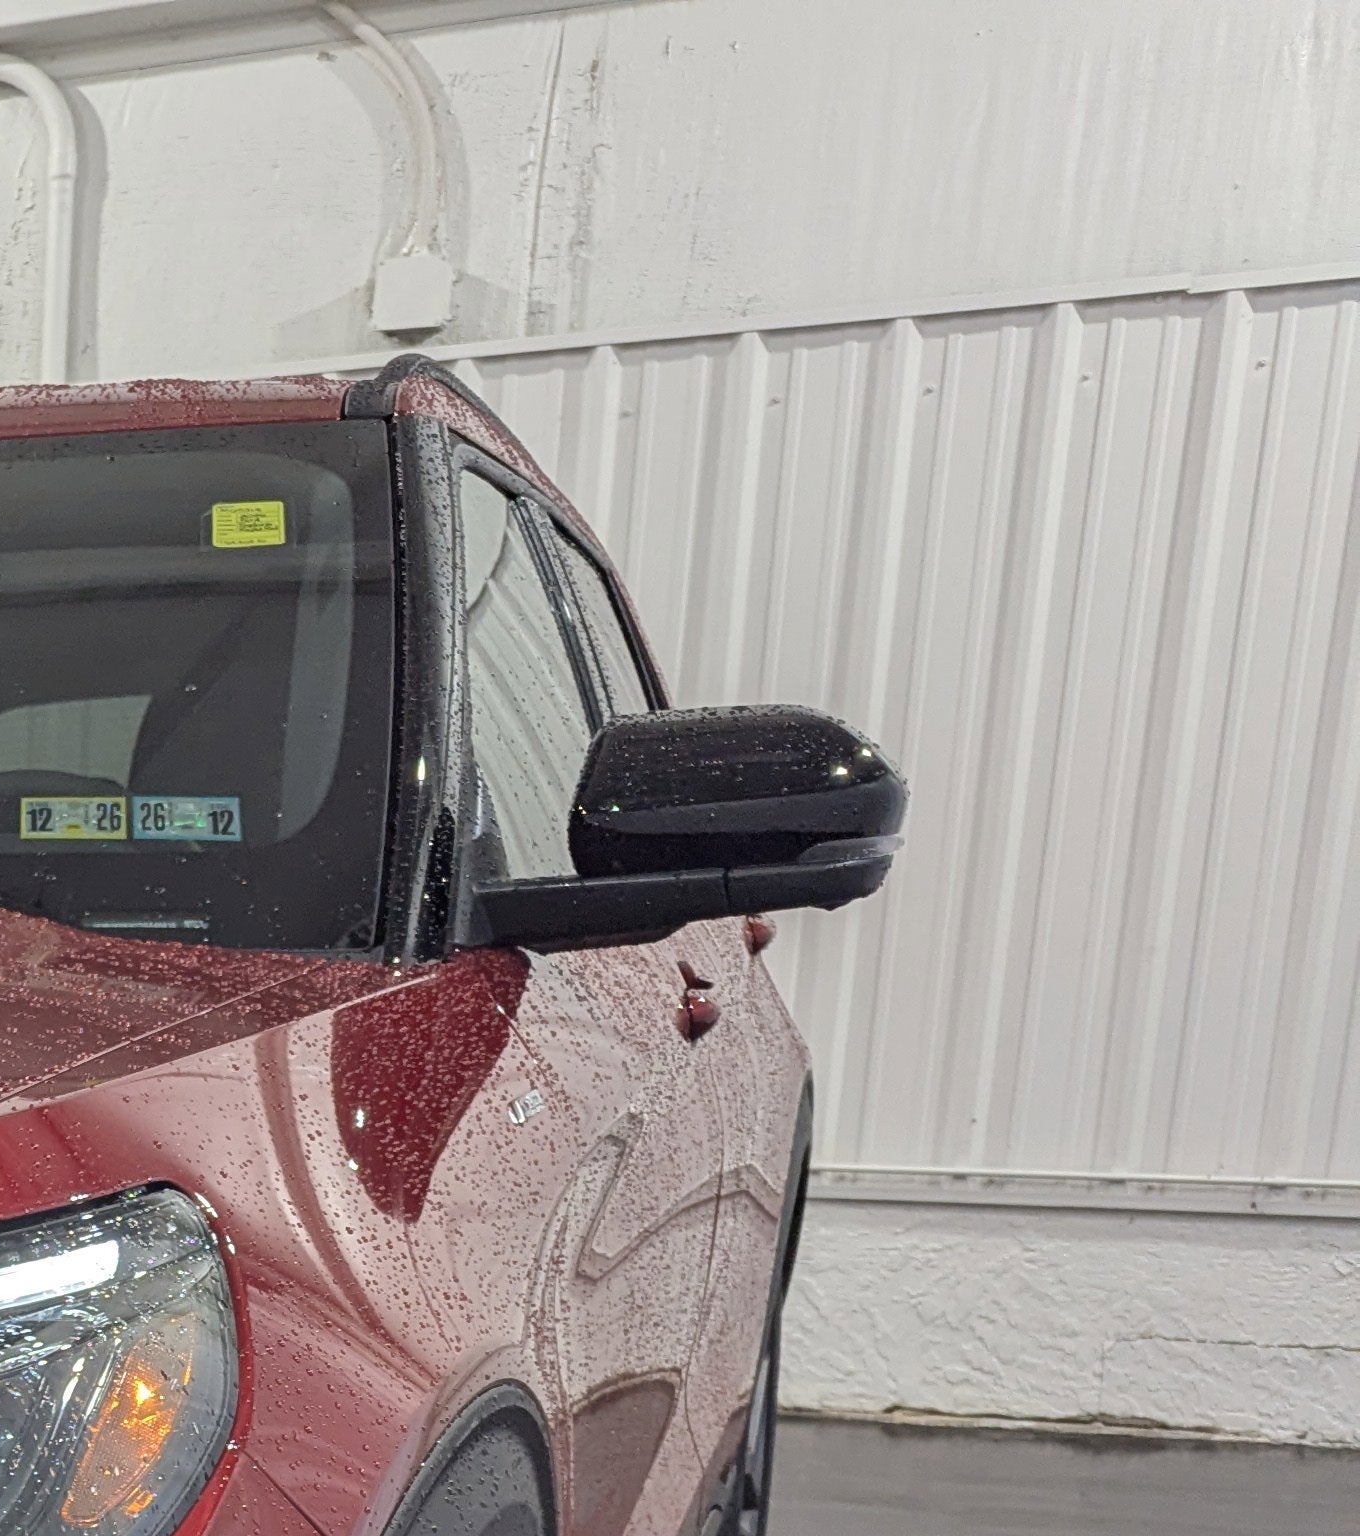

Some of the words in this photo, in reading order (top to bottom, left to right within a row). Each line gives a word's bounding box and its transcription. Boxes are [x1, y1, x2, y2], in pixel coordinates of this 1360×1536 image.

[27, 808, 53, 832] 12
[96, 803, 121, 831] 26
[140, 803, 166, 831] 26
[208, 810, 235, 835] 12
